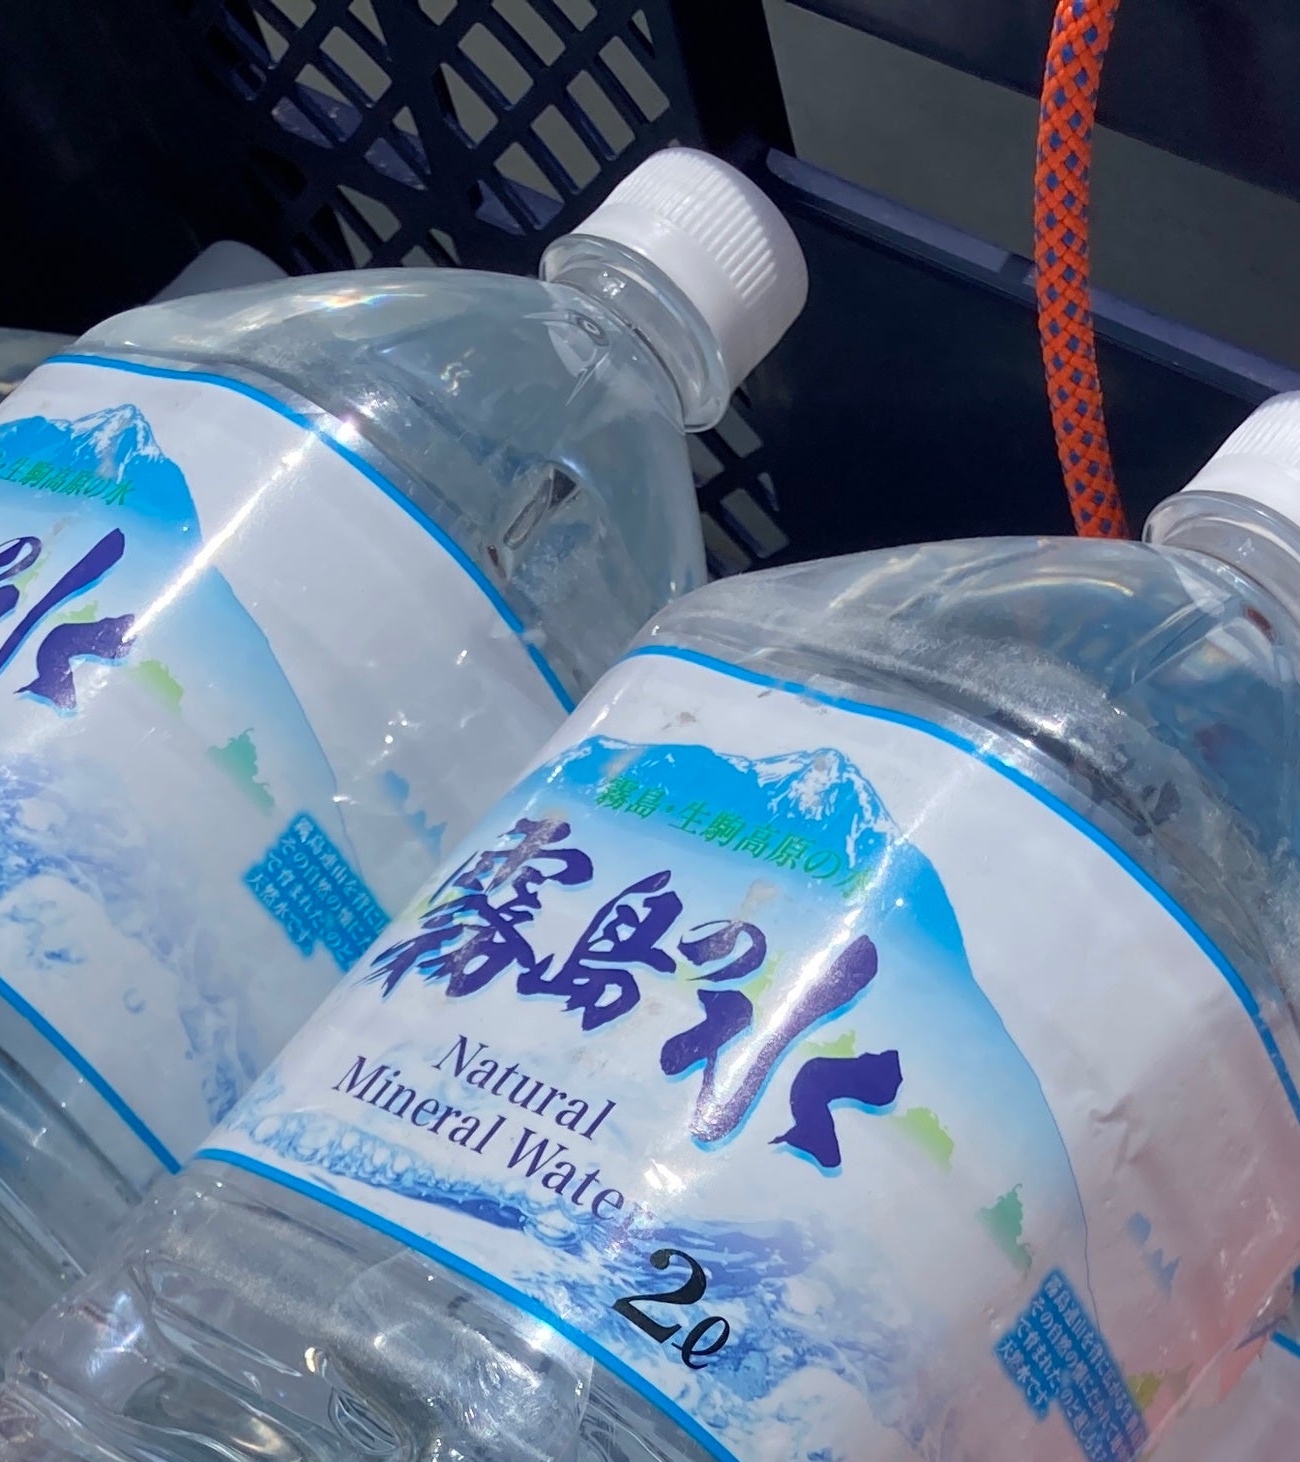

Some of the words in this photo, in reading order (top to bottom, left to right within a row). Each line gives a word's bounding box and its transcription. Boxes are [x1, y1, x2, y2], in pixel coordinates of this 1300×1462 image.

[355, 818, 903, 1168] 霧島の水
[332, 1056, 505, 1154] Mineral
[432, 1035, 616, 1140] Natural
